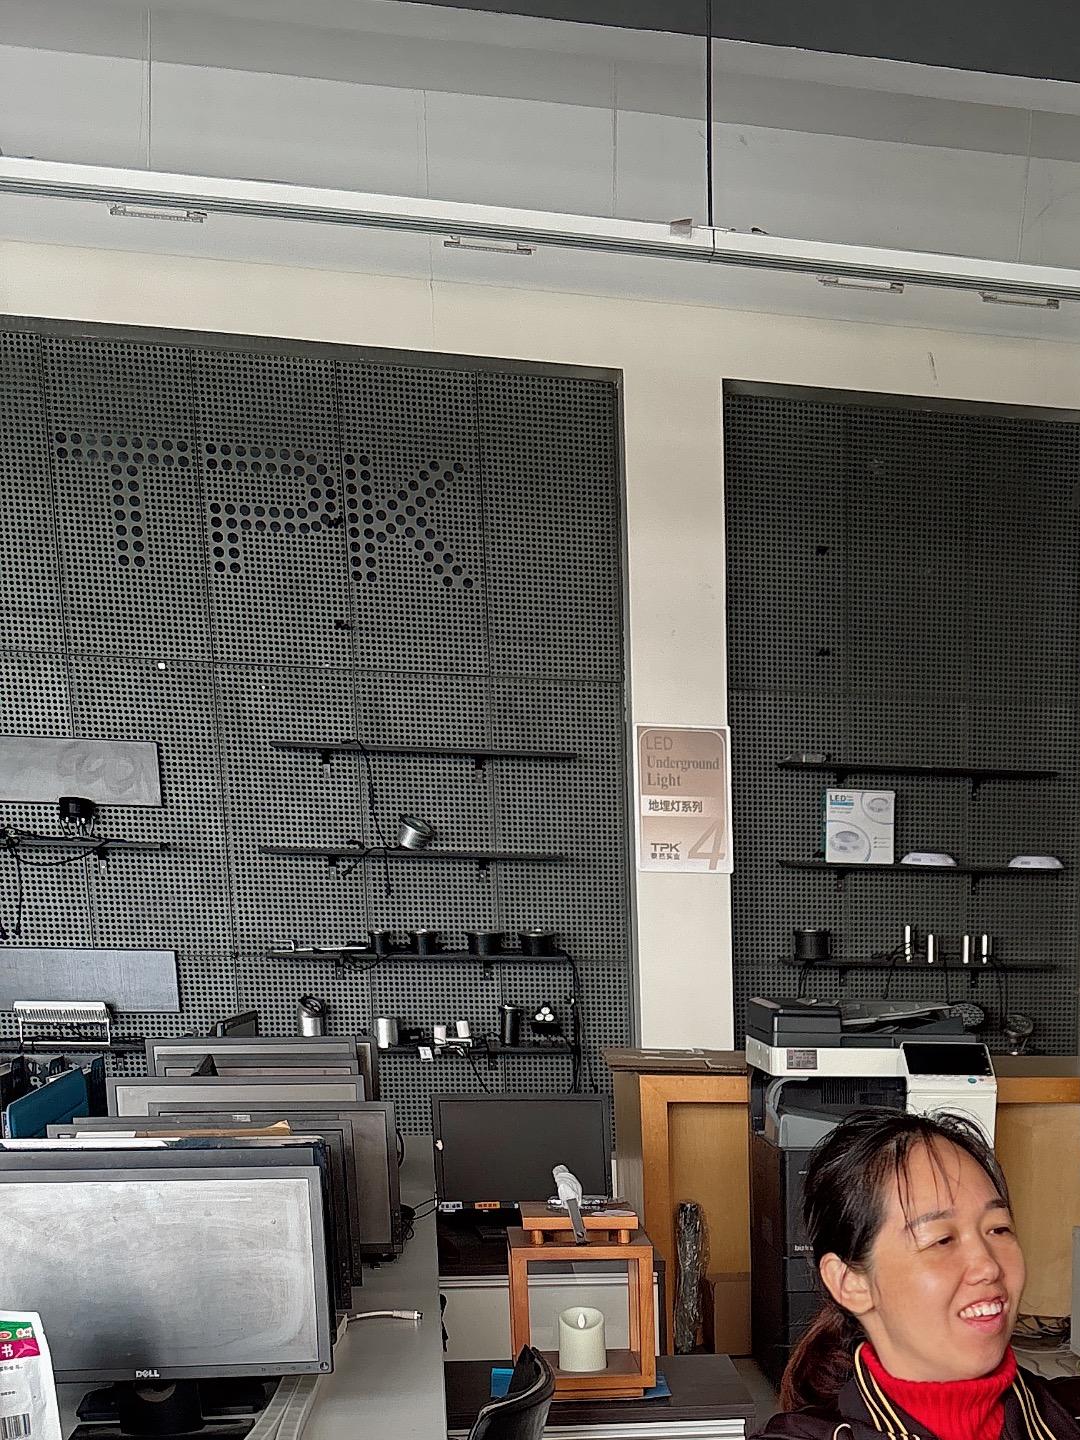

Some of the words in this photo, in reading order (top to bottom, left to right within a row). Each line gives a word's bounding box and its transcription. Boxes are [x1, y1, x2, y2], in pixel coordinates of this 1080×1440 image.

[55, 430, 474, 590] TPK
[646, 736, 673, 751] LED
[646, 755, 720, 772] Underground
[647, 773, 681, 789] Light
[829, 794, 847, 802] LED
[648, 799, 703, 813] 地埋灯系列
[650, 842, 681, 853] TPK
[687, 818, 726, 871] 4
[135, 1369, 160, 1378] DELL
